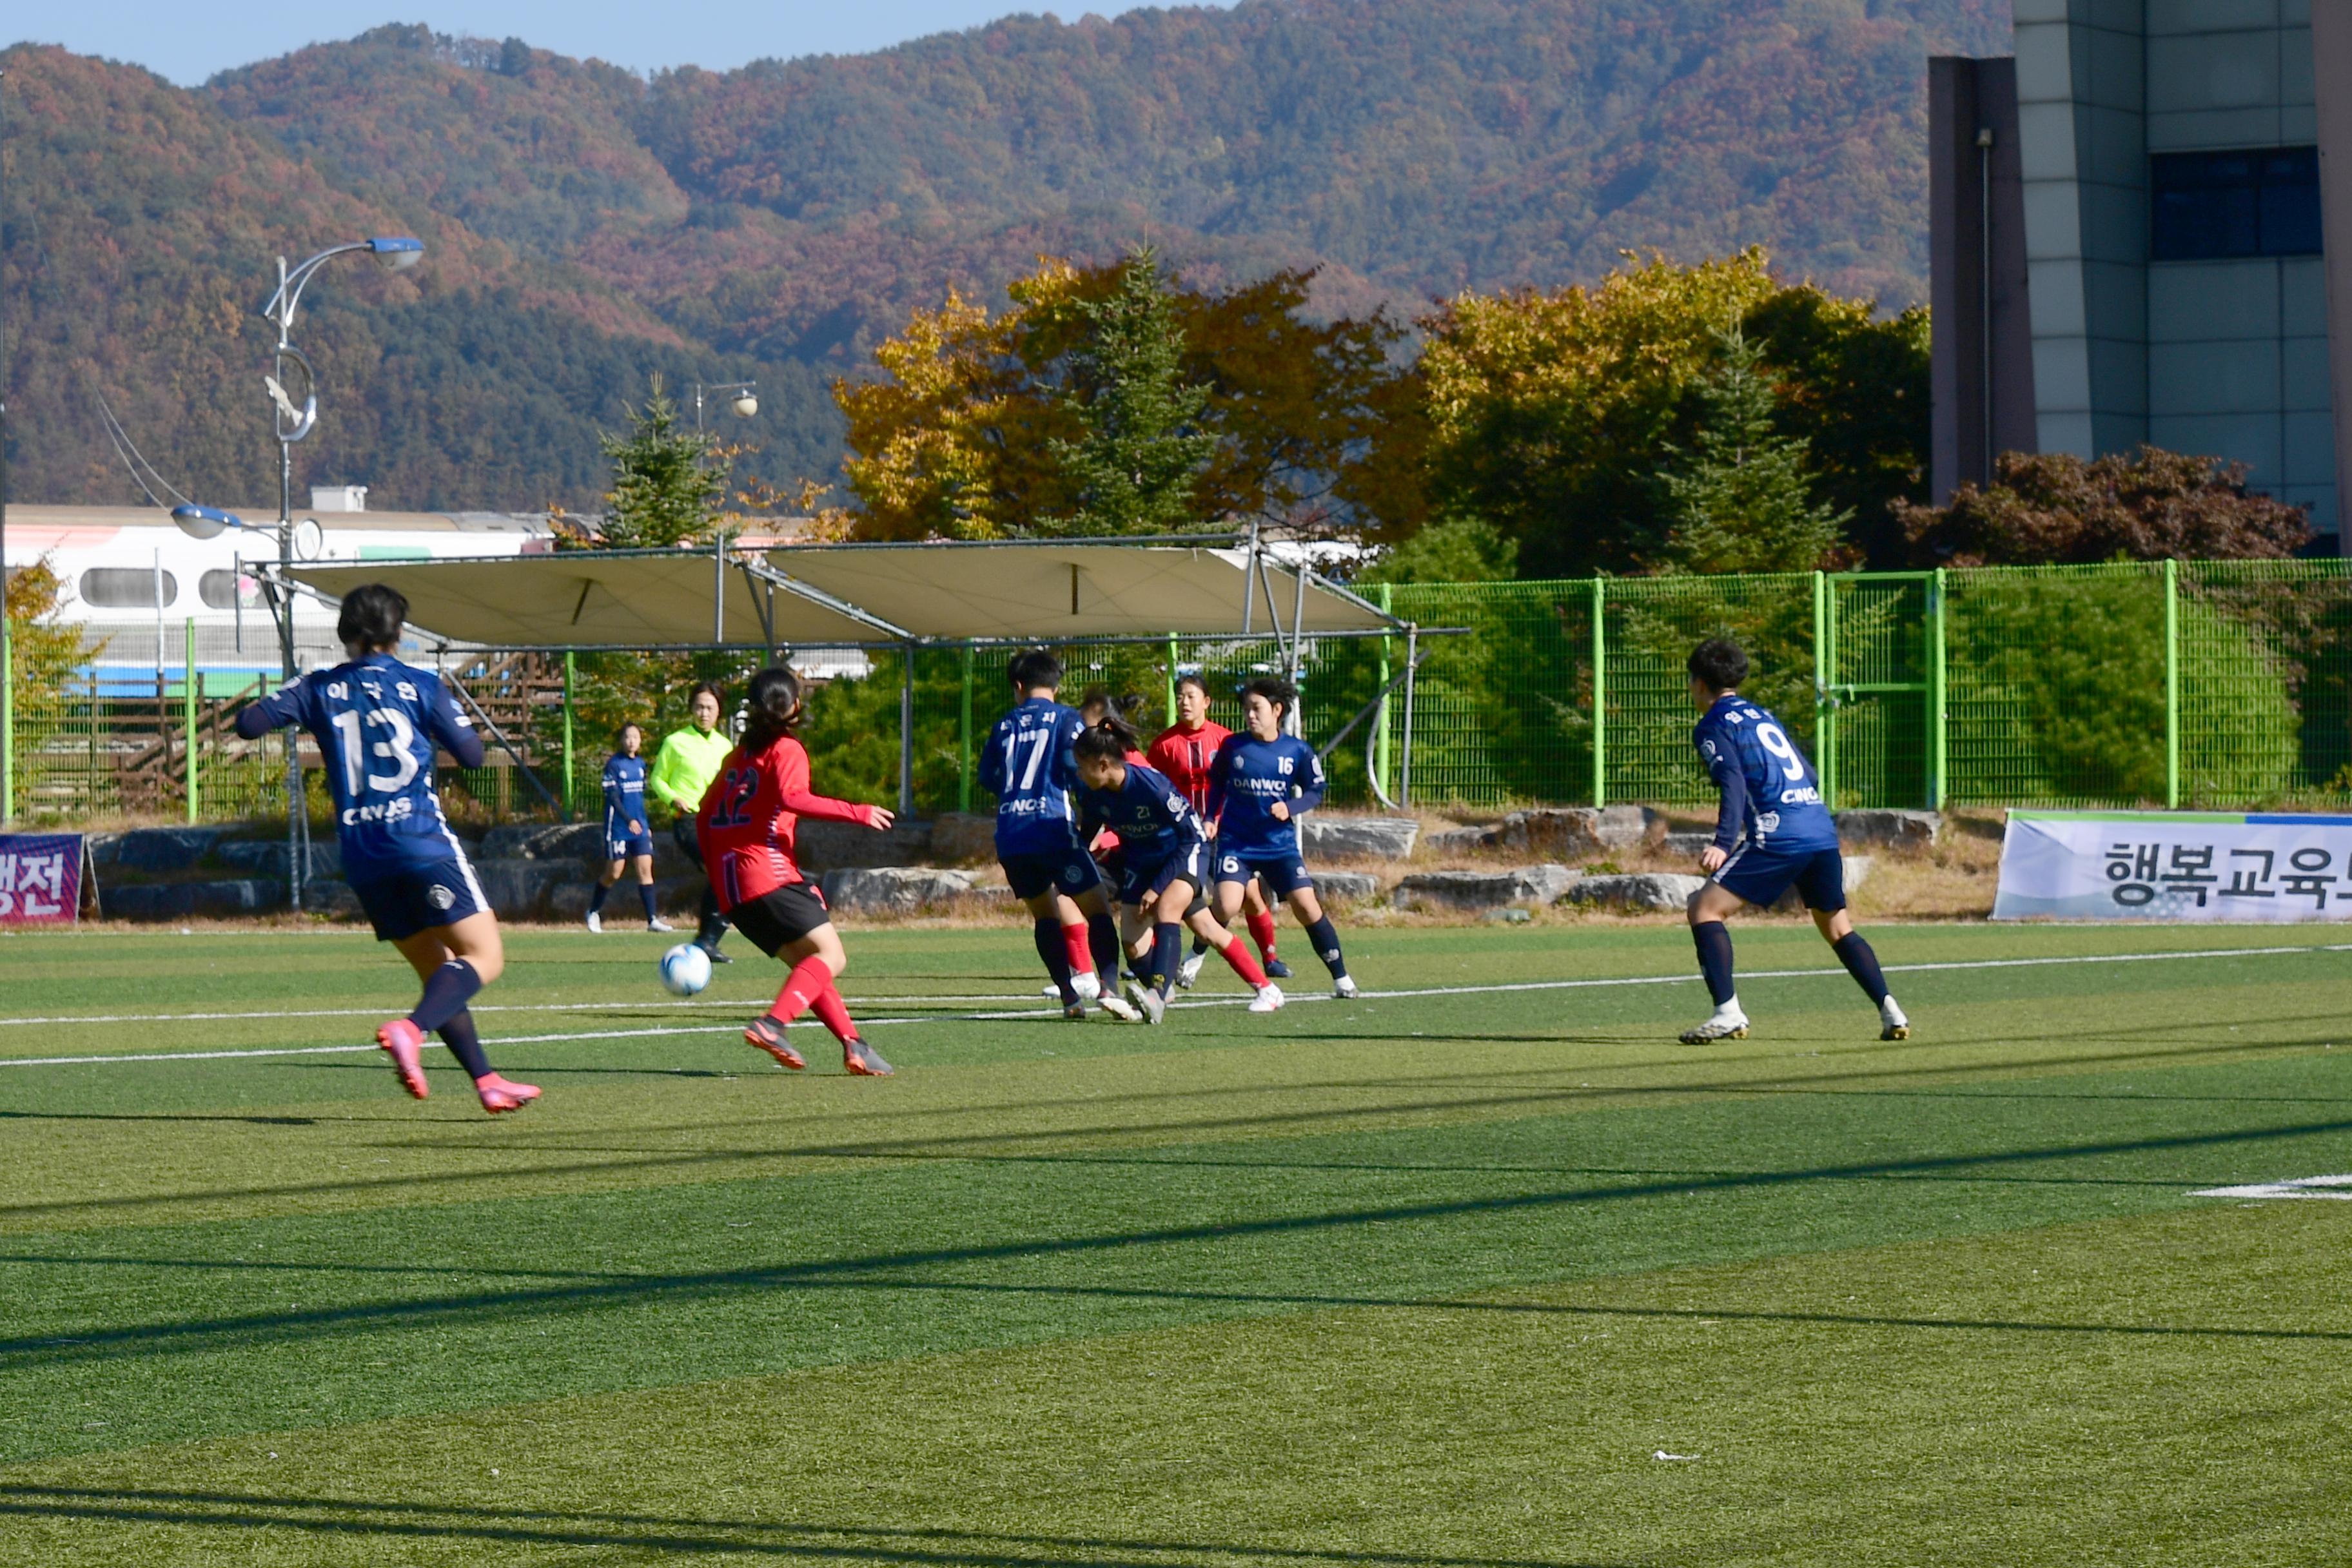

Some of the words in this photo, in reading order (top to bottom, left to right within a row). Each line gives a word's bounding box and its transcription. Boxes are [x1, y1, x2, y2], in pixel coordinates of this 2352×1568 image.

[331, 707, 419, 797] 13
[1001, 728, 1049, 794] 17
[1278, 756, 1294, 775] 16
[1756, 722, 1805, 781] 9
[710, 767, 759, 827] 12
[1217, 856, 1239, 874] 16
[2104, 843, 2352, 910] 행복교육
